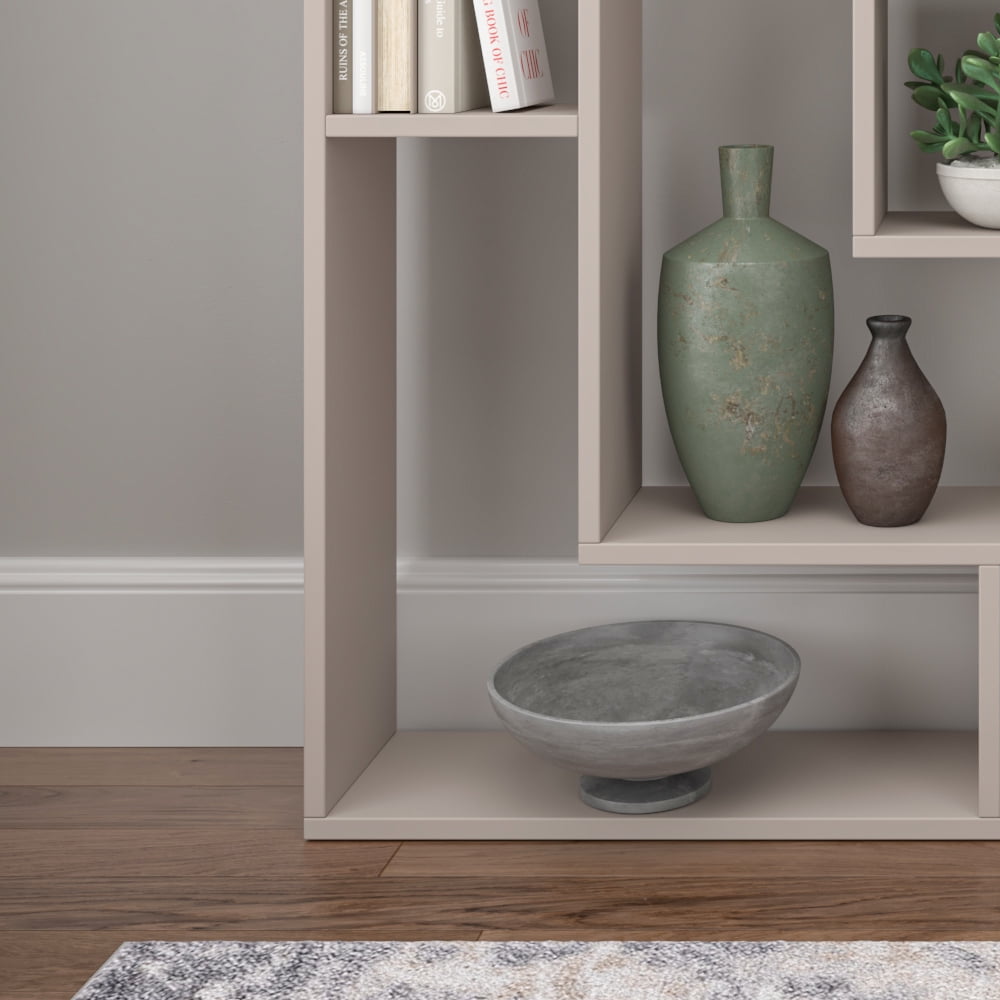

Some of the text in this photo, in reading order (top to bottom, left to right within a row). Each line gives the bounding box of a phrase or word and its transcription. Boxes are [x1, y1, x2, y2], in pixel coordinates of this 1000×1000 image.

[338, 9, 348, 30] THE
[436, 27, 445, 39] to
[485, 9, 499, 44] BOOK
[517, 8, 530, 38] OF
[338, 32, 348, 47] OF
[338, 48, 348, 81] RUINS
[491, 48, 504, 65] OF
[520, 49, 544, 80] CHIC
[495, 67, 510, 99] CHIC
